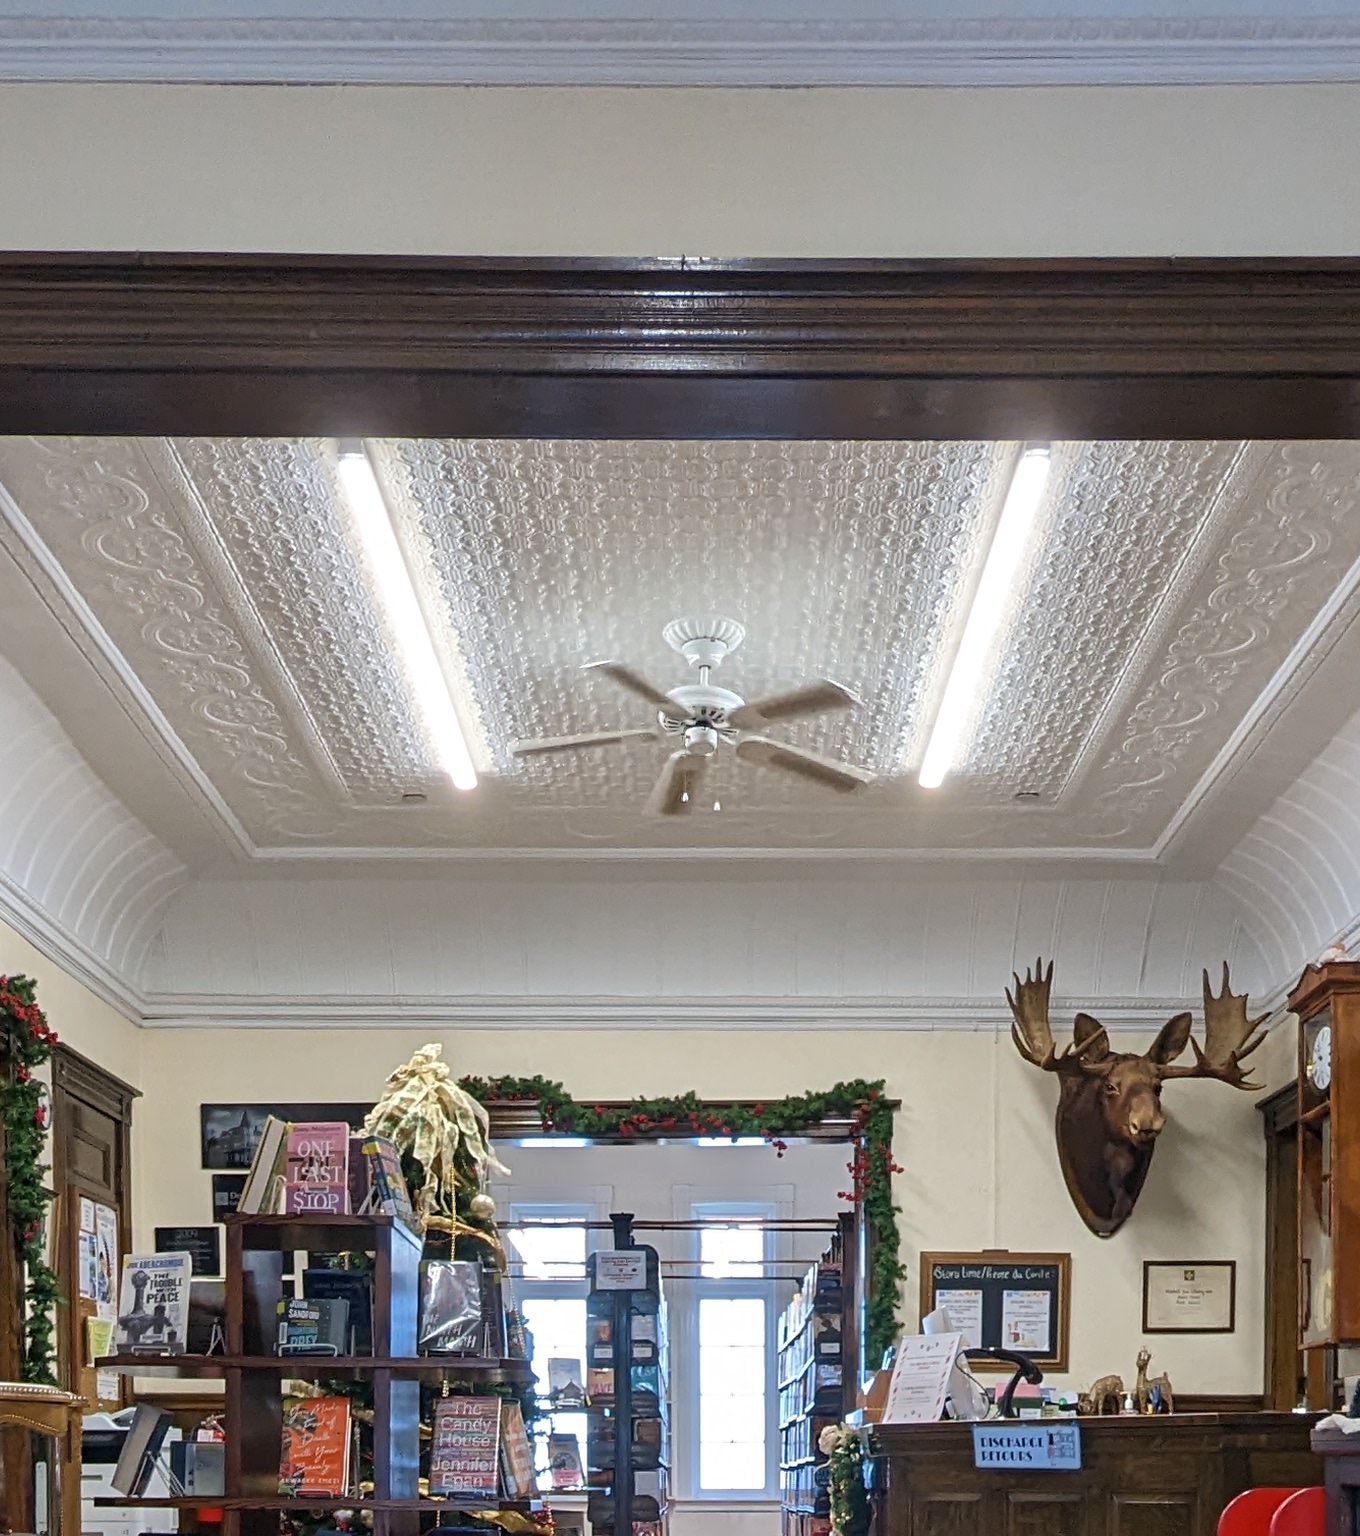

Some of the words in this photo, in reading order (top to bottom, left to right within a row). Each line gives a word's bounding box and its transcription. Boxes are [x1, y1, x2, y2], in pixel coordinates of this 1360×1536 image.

[297, 1140, 334, 1158] ONE
[293, 1166, 343, 1184] LAST
[293, 1191, 340, 1209] STOP
[146, 1291, 180, 1304] PEACE
[454, 1401, 482, 1415] The
[440, 1416, 492, 1435] Candy
[439, 1433, 491, 1447] House
[980, 1437, 1044, 1448] DISCHARGE
[981, 1450, 1033, 1461] RETOURS
[431, 1456, 497, 1472] Jennifer
[441, 1472, 483, 1490] Egan
